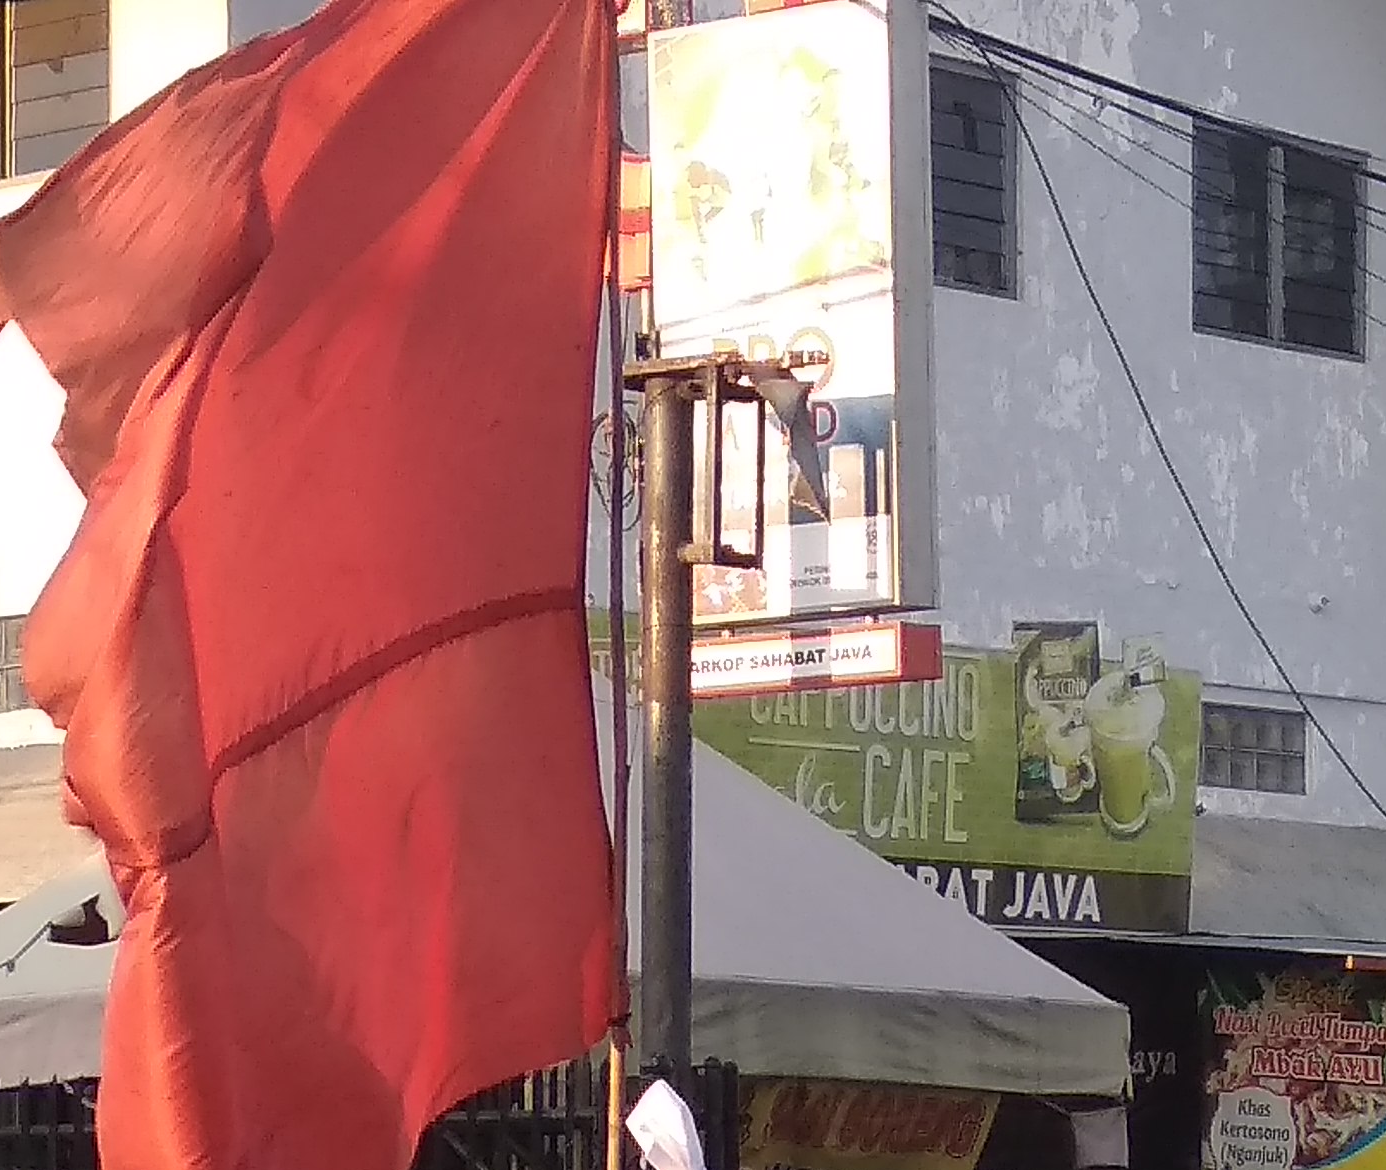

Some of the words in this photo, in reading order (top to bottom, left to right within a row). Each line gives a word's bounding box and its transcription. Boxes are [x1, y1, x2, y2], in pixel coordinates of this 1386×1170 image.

[690, 658, 743, 673] ARKOP
[750, 649, 826, 669] SAHABAT
[831, 645, 872, 661] JAVA
[863, 746, 972, 843] CAFE
[1003, 871, 1101, 923] JAVA
[1213, 1006, 1260, 1034] Nasi
[1326, 1055, 1383, 1084] AYU
[1238, 1098, 1271, 1116] Khas
[1220, 1120, 1290, 1142] Kertosono
